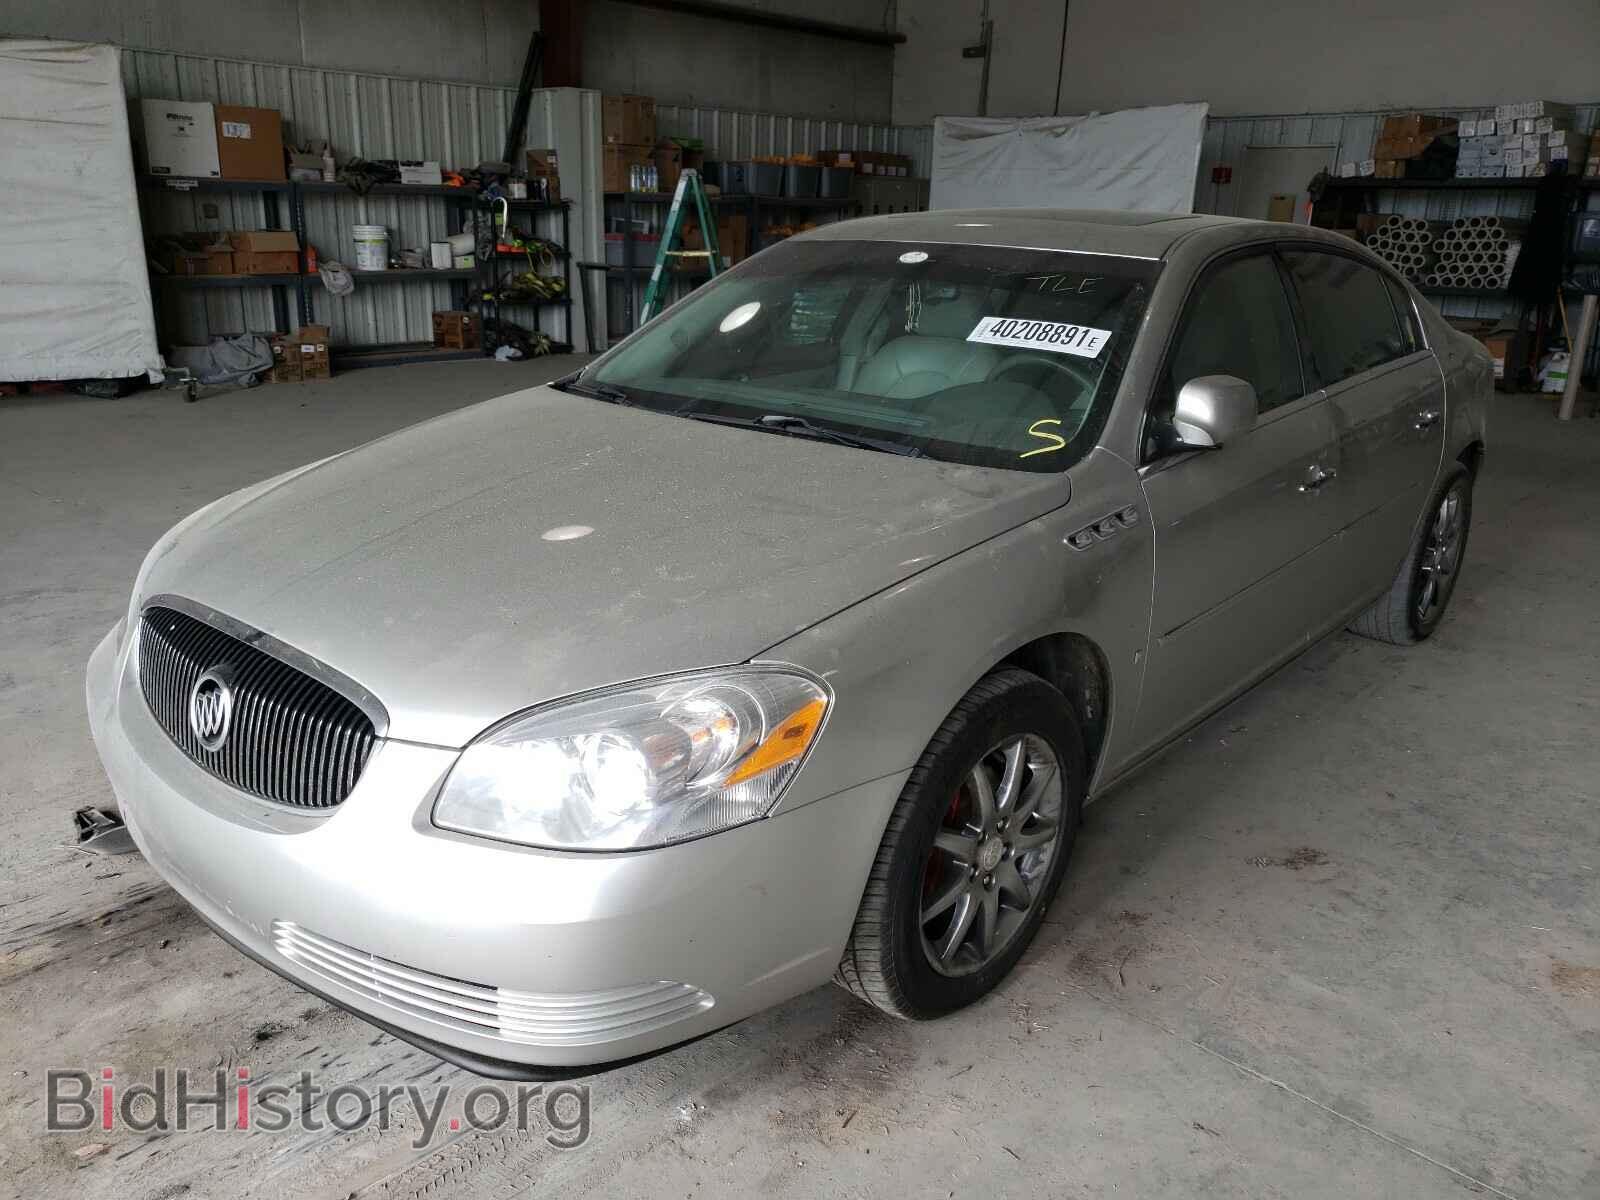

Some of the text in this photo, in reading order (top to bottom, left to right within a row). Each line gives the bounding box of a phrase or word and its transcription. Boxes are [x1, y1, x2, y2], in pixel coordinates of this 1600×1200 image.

[990, 320, 1090, 346] 40208891
[1089, 337, 1100, 347] E
[1019, 419, 1066, 458] S
